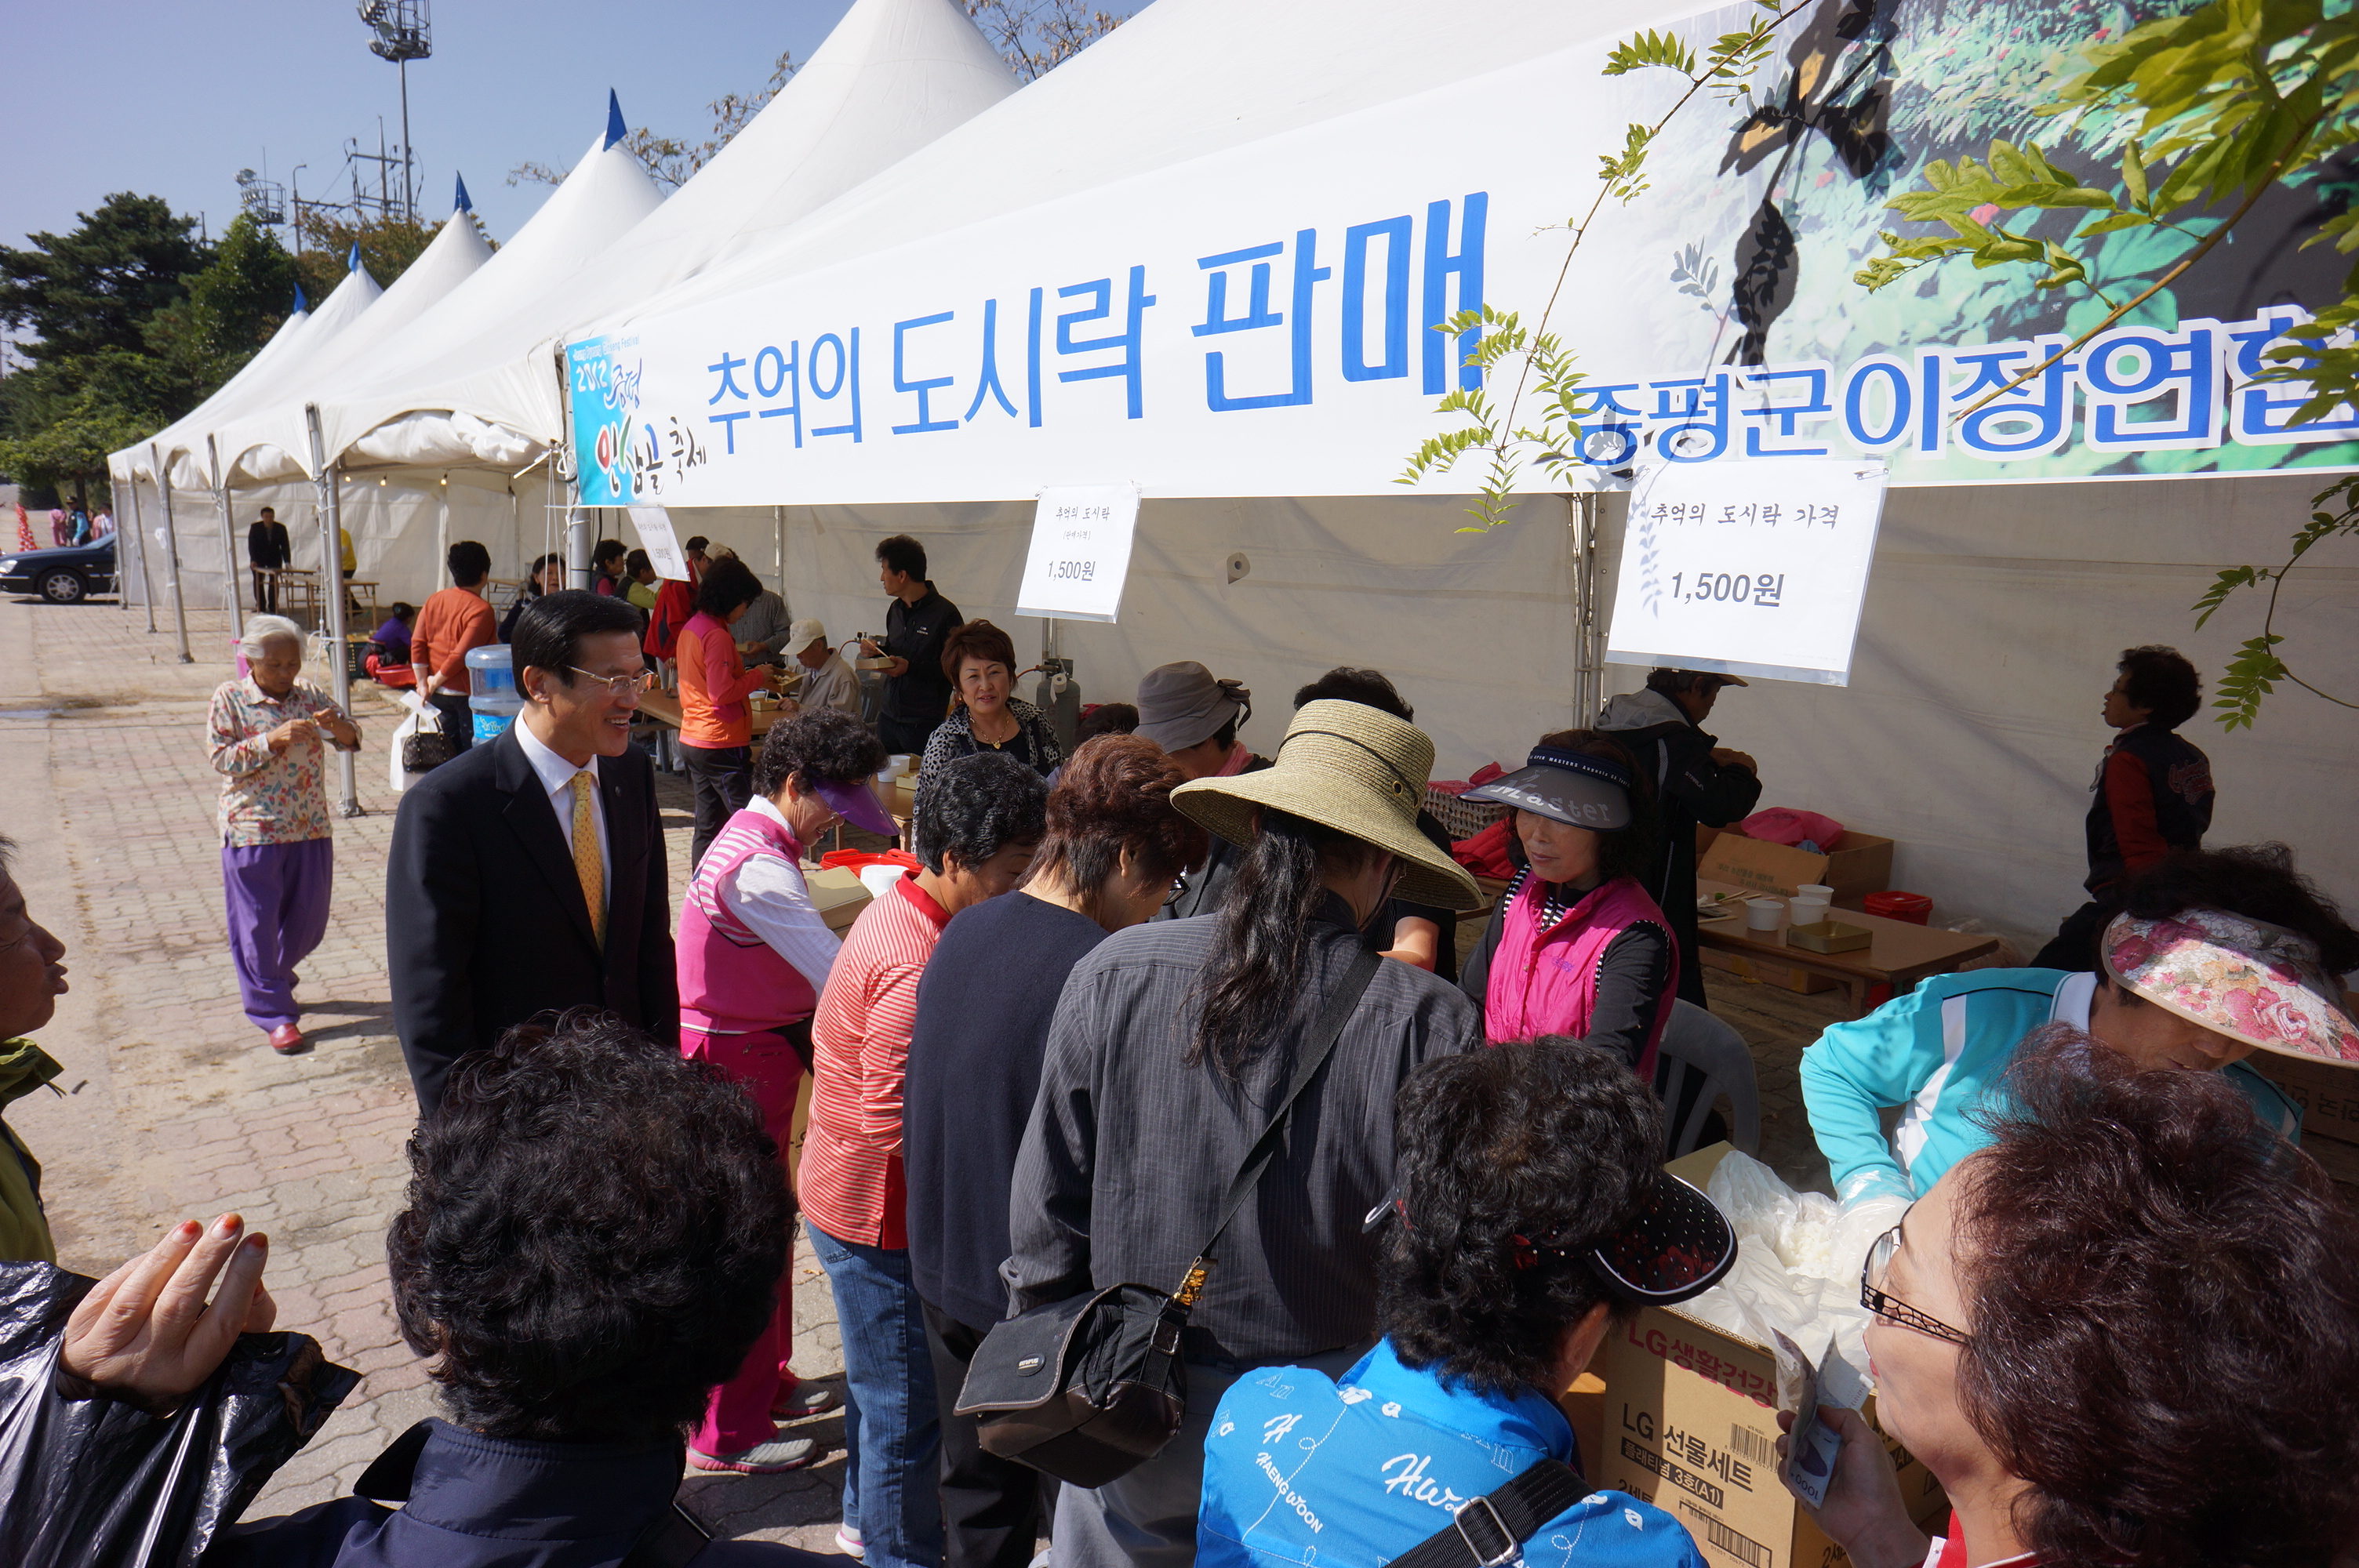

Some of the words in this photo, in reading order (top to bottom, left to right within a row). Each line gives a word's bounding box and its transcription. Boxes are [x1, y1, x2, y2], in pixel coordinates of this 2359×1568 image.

[707, 325, 863, 456] 추억의
[891, 264, 1157, 436] 도시락
[1190, 191, 1488, 413] 판매
[576, 359, 608, 392] 2012
[669, 416, 707, 485] 축제
[1056, 506, 1079, 522] 추억의
[1081, 506, 1110, 521] 도시락
[1650, 502, 1707, 528] 추억의
[1717, 502, 1783, 528] 도시락
[1793, 503, 1840, 530] 가격
[1063, 530, 1092, 541] (판매가격)
[1047, 560, 1096, 582] 1,500원
[1671, 572, 1786, 608] 1,500원
[1548, 757, 1579, 768] MASTERS
[1491, 779, 1611, 822] Master
[1628, 1320, 1778, 1409] LG생활건강
[1622, 1403, 1655, 1442] LG
[1663, 1425, 1754, 1493] 선물세트
[1623, 1440, 1670, 1479] 플래티넘
[1674, 1468, 1721, 1505] 3호(A1)
[1256, 1452, 1291, 1497] HAENG
[1286, 1491, 1324, 1534] WOON
